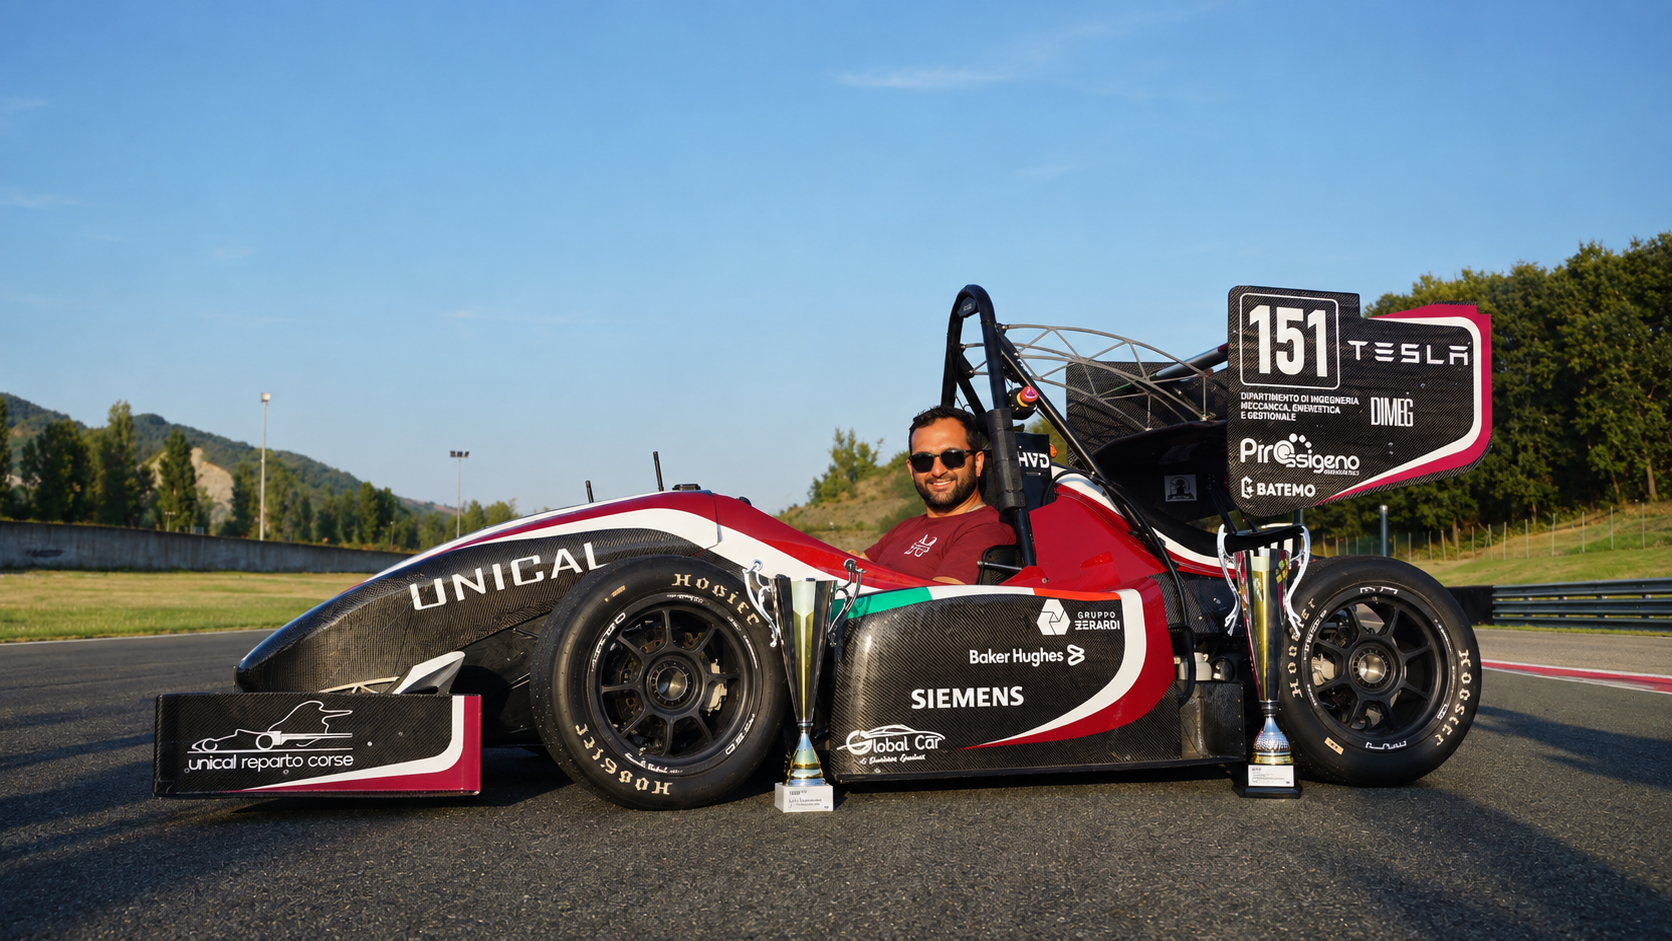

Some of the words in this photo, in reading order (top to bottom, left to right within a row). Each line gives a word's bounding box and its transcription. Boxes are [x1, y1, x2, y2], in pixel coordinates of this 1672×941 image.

[1249, 304, 1328, 378] 151
[1347, 340, 1469, 365] TESLA
[1240, 411, 1247, 419] E
[1370, 396, 1414, 427] DIMEG
[1256, 482, 1316, 498] BATEMO
[409, 542, 609, 611] UNICAL
[1077, 611, 1116, 620] GRUPPO
[969, 648, 1011, 664] Baker
[1013, 647, 1064, 667] Hughes
[911, 686, 1025, 710] SIEMENS
[845, 729, 910, 756] Global
[914, 734, 943, 750] Car
[188, 754, 237, 771] unical
[240, 753, 304, 773] reparto
[307, 754, 354, 768] corse
